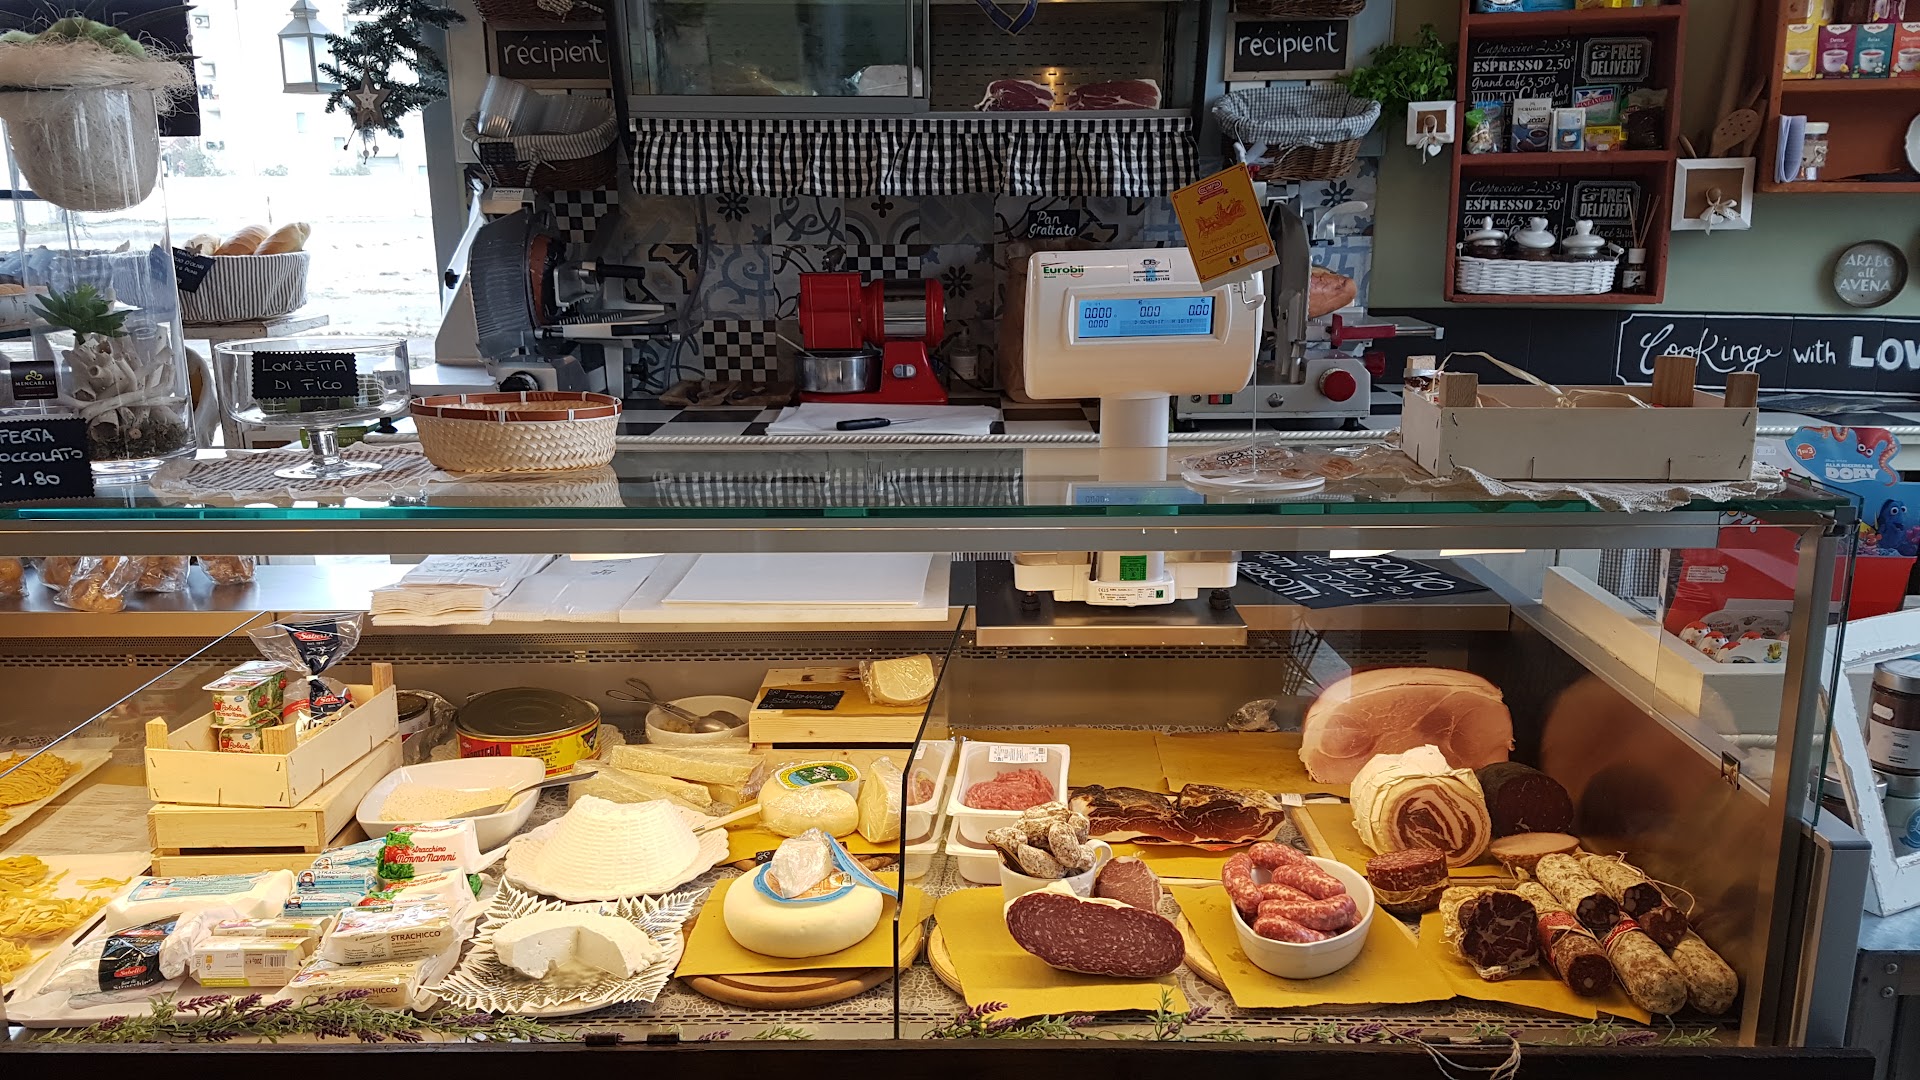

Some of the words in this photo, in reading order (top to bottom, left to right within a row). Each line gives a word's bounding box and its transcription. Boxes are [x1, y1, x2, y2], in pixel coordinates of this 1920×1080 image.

[1239, 25, 1339, 63] récipient
[1477, 41, 1533, 61] Cappuccino
[503, 34, 606, 72] récipient
[1611, 44, 1642, 59] FREE
[1473, 60, 1543, 73] ESPRESSO
[1590, 60, 1641, 76] DELIVERY
[1471, 75, 1503, 90] Grand
[1469, 181, 1524, 200] Cappuccino
[1600, 188, 1631, 202] FREE
[1465, 199, 1534, 211] ESPRESSO
[1580, 203, 1629, 217] DELIVERY
[1036, 211, 1061, 225] Pan
[1028, 223, 1077, 238] Grattato
[1845, 254, 1895, 268] ARABO
[1839, 279, 1893, 292] AVENA
[1793, 339, 1836, 365] with
[262, 358, 348, 372] LONZETTA
[274, 380, 292, 390] DI
[11, 471, 61, 486] 1.80
[1825, 467, 1880, 480] DORY
[1354, 557, 1456, 591] CONTO
[412, 845, 447, 854] stracchino
[390, 930, 441, 942] STRACHICCO
